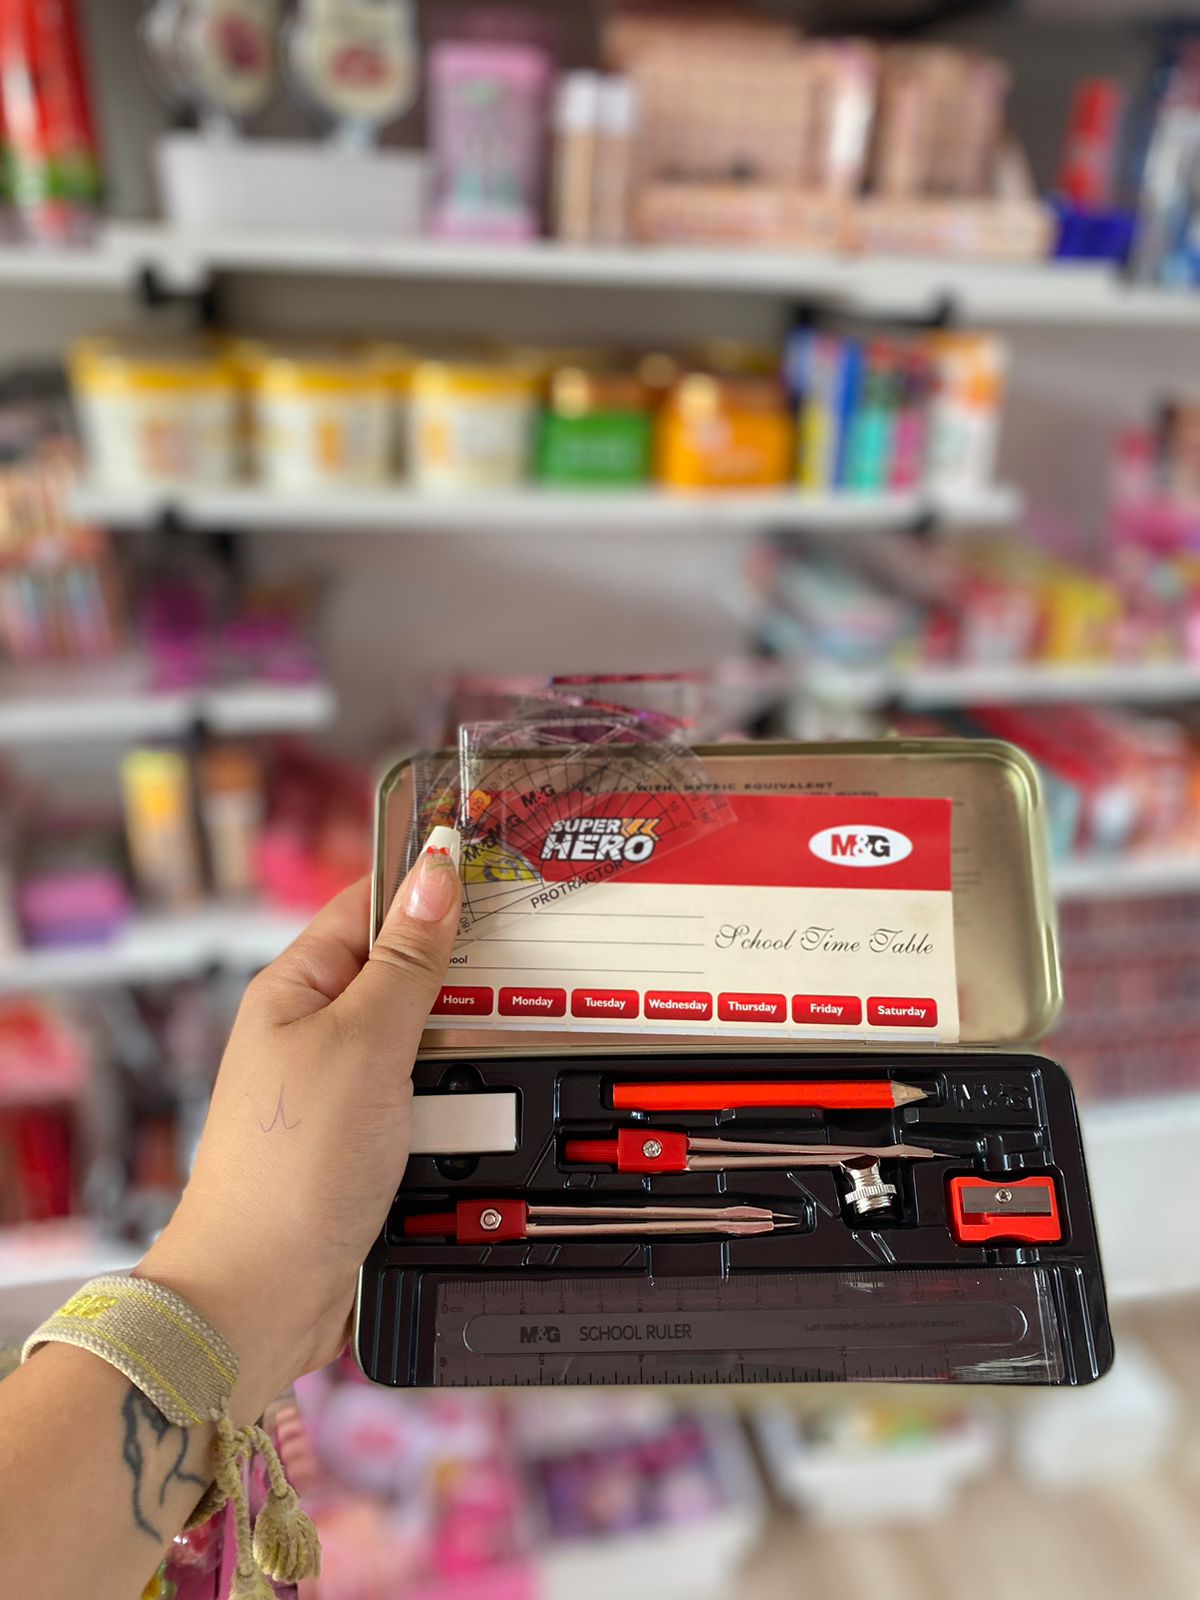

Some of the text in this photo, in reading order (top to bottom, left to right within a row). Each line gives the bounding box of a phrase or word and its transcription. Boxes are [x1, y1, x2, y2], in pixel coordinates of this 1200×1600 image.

[744, 781, 834, 791] EQUIVALENT
[550, 818, 622, 834] SUPER
[541, 833, 656, 863] HERO
[830, 833, 891, 858] M&G
[530, 859, 624, 910] PROTRACTOR
[714, 923, 934, 955] School Time Table
[443, 994, 926, 1018] Hours Monday Tuesday Wednesday Thursday Friday Saturday
[520, 1323, 692, 1344] M&G SCHOOL RULER
